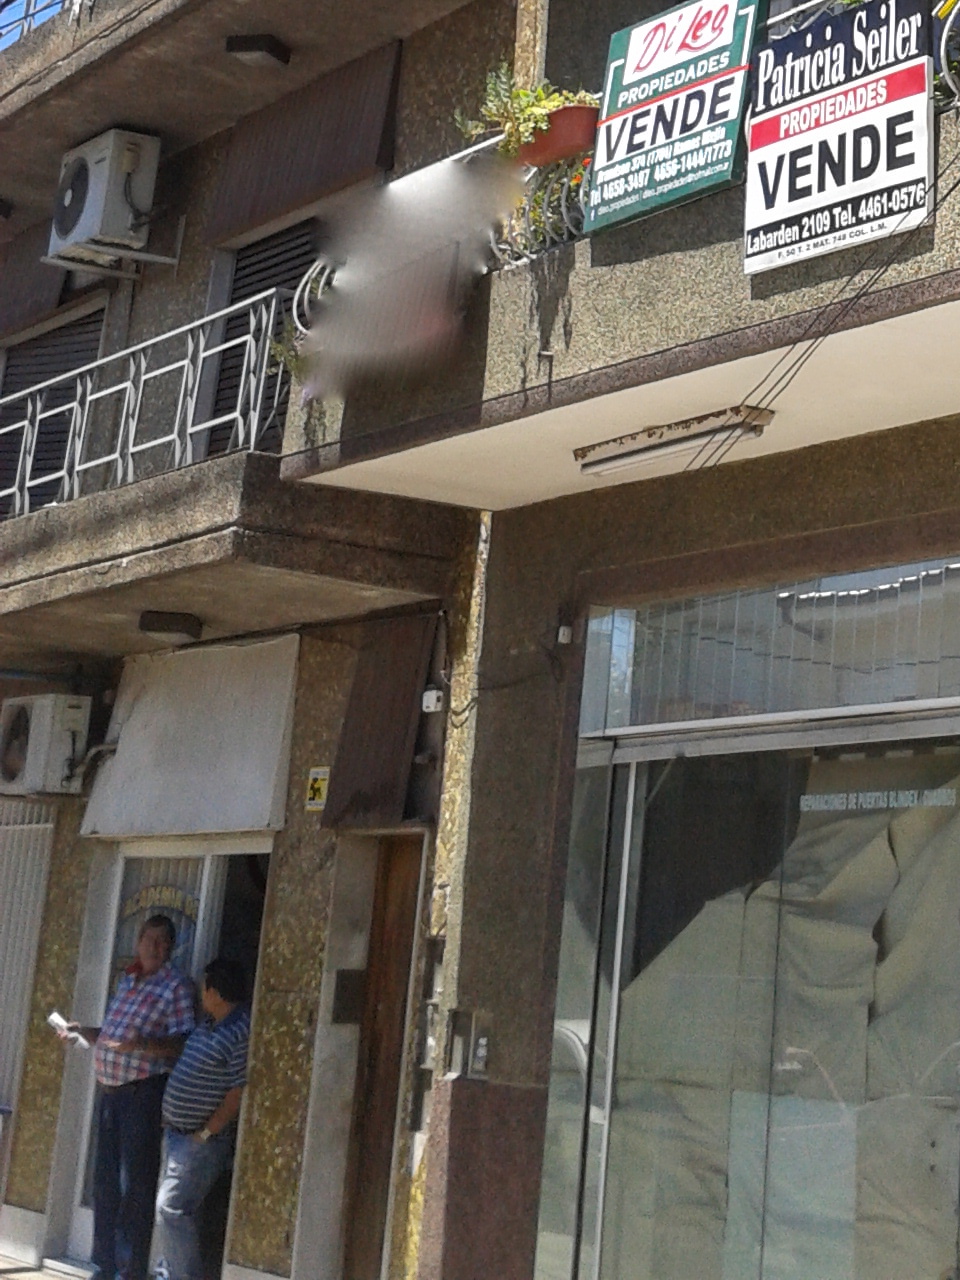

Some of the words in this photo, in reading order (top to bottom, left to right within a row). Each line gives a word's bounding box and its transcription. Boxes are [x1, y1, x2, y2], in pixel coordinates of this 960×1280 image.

[634, 15, 682, 73] Di
[677, 3, 730, 54] Leo
[755, 26, 846, 113] Patricia
[617, 52, 730, 108] PROPIEDADES
[779, 80, 887, 139] PROPIEDADES
[605, 77, 735, 163] VENDE
[757, 110, 915, 210] VENDE
[747, 224, 800, 255] Labarden
[801, 210, 831, 237] 2109
[832, 203, 856, 229] Tel.
[858, 182, 926, 221] 4461-0576
